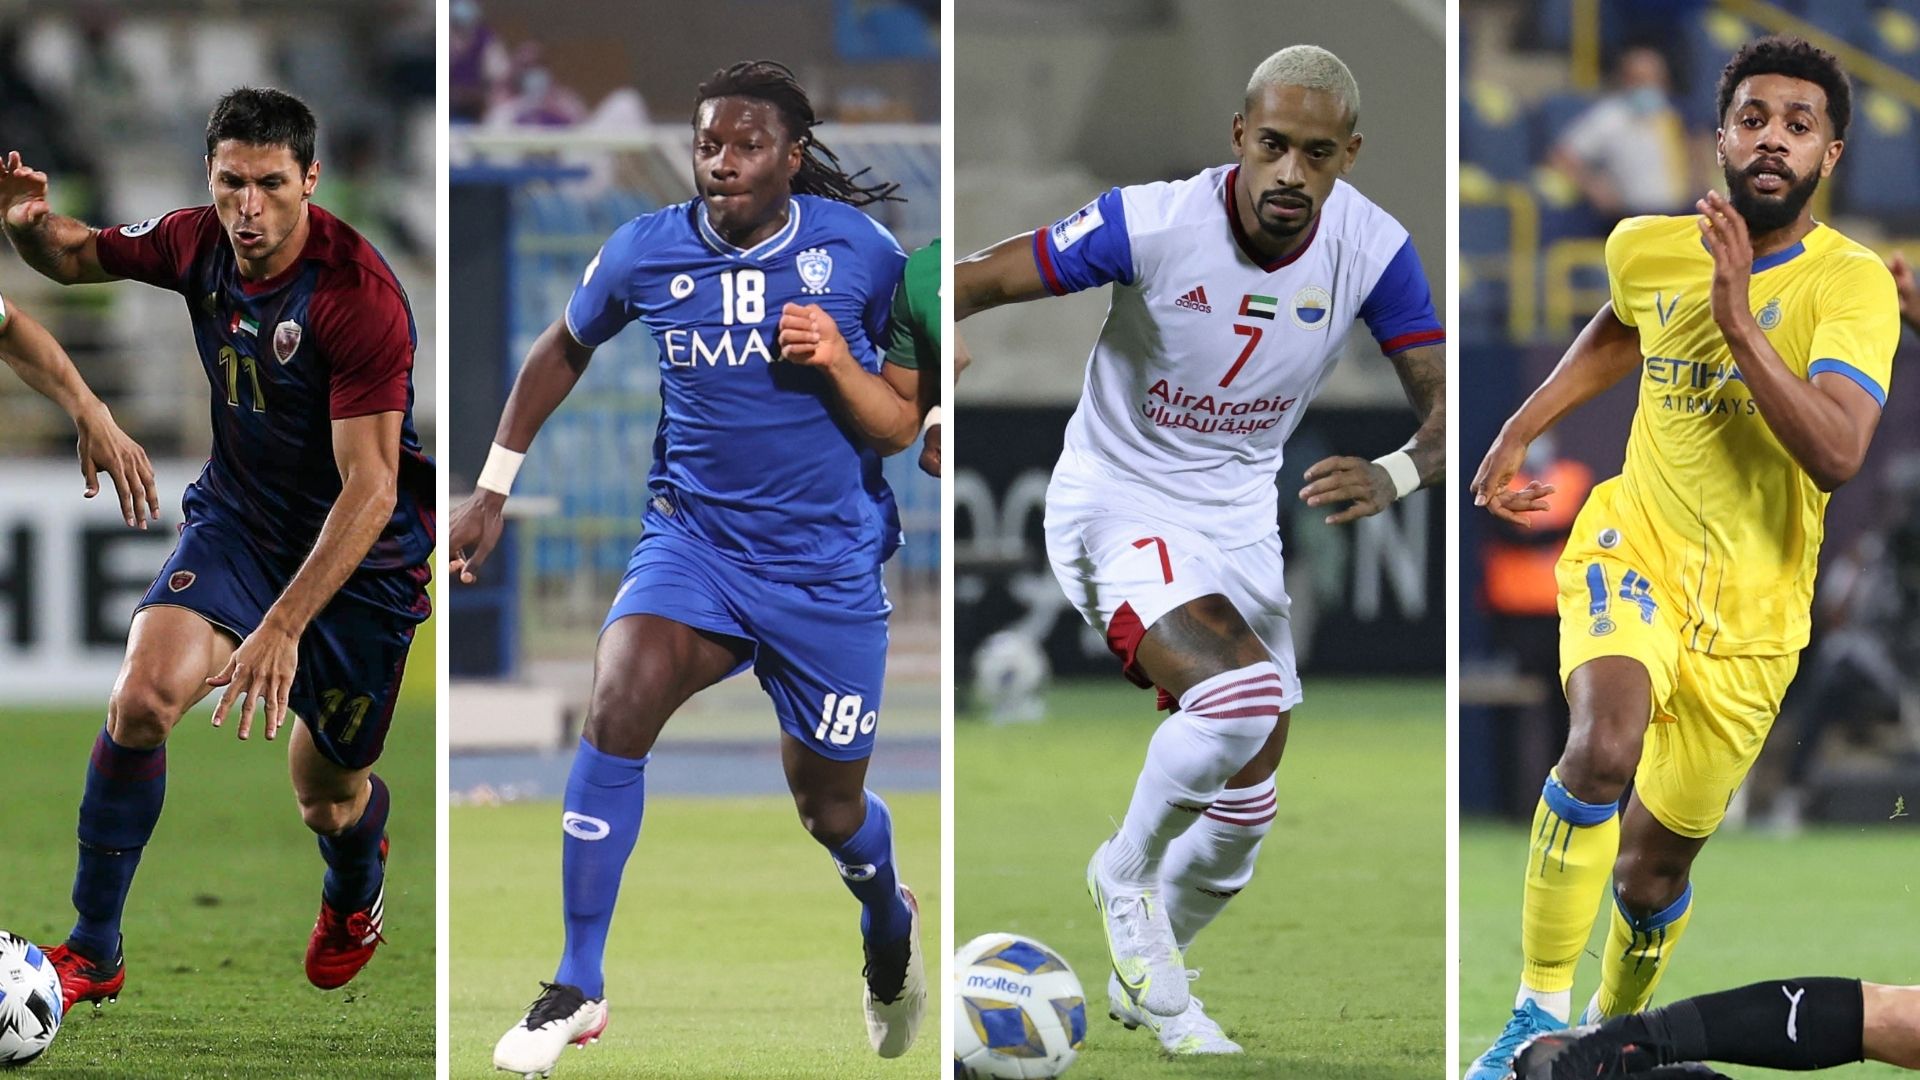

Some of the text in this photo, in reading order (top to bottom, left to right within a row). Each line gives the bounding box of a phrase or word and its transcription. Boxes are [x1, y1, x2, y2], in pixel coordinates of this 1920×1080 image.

[720, 269, 765, 325] 18
[1174, 298, 1212, 314] adidas
[665, 328, 776, 367] EMA
[1218, 324, 1263, 388] 7
[219, 345, 266, 413] 11
[1663, 394, 1756, 415] AIRWAYS
[1131, 536, 1174, 585] 7
[1586, 562, 1659, 625] 14
[318, 688, 372, 744] 11
[815, 693, 862, 745] 18
[967, 975, 1032, 998] molten
